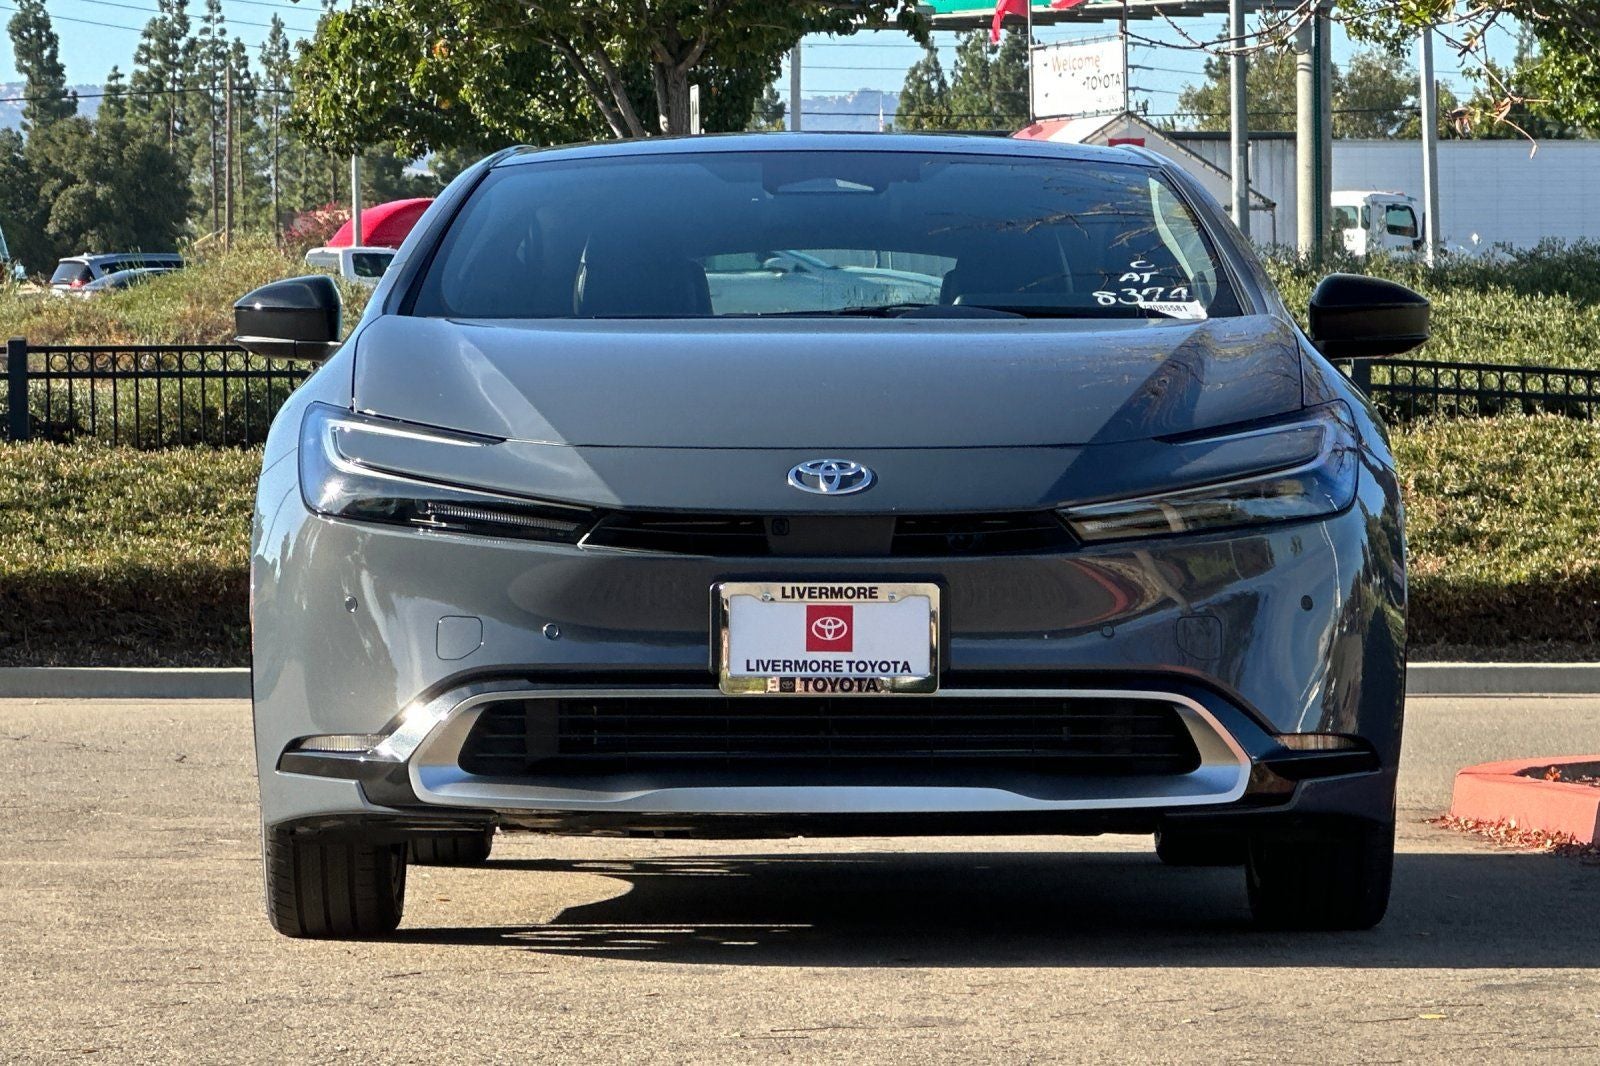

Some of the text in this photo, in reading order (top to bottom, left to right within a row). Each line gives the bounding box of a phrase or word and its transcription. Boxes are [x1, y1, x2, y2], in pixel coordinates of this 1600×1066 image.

[1052, 55, 1100, 72] Welcome
[1086, 74, 1120, 90] TOYOTA
[1120, 272, 1158, 283] AT
[781, 587, 879, 599] LIVERMORE
[746, 659, 912, 674] LIVERMORE TOYOTA
[802, 677, 880, 692] TOYOTA
